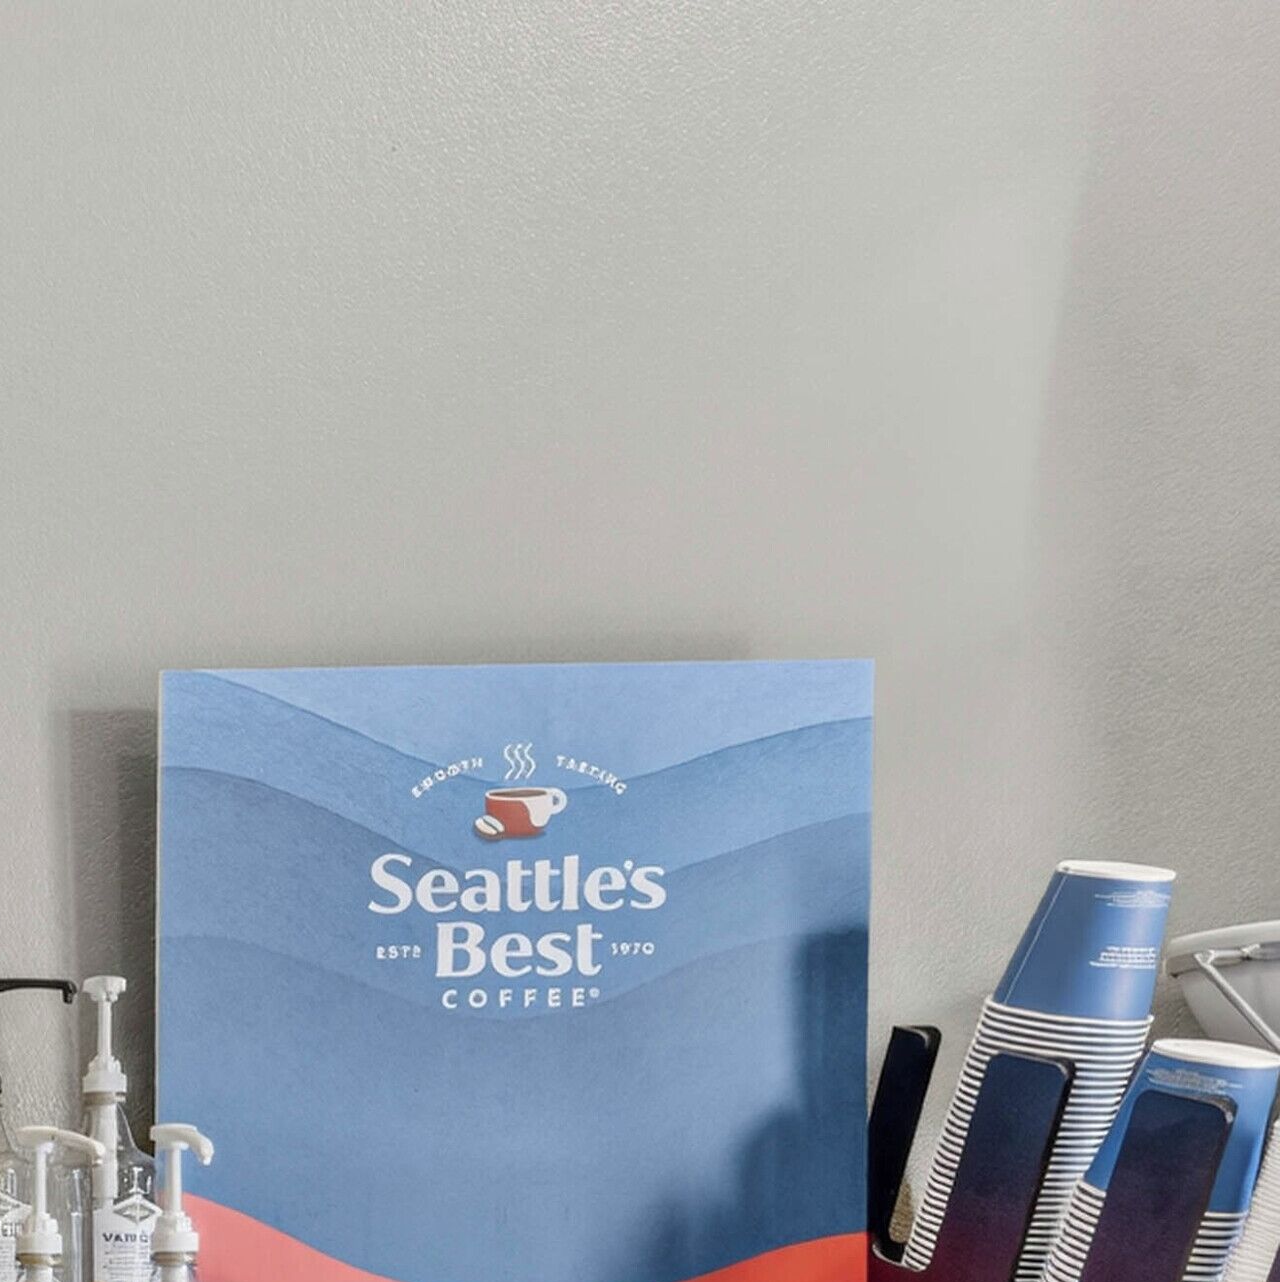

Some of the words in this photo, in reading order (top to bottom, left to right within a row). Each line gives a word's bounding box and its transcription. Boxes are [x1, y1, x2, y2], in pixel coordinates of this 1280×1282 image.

[555, 754, 628, 795] TASTING
[368, 853, 667, 915] Seattle's
[435, 921, 604, 977] Best
